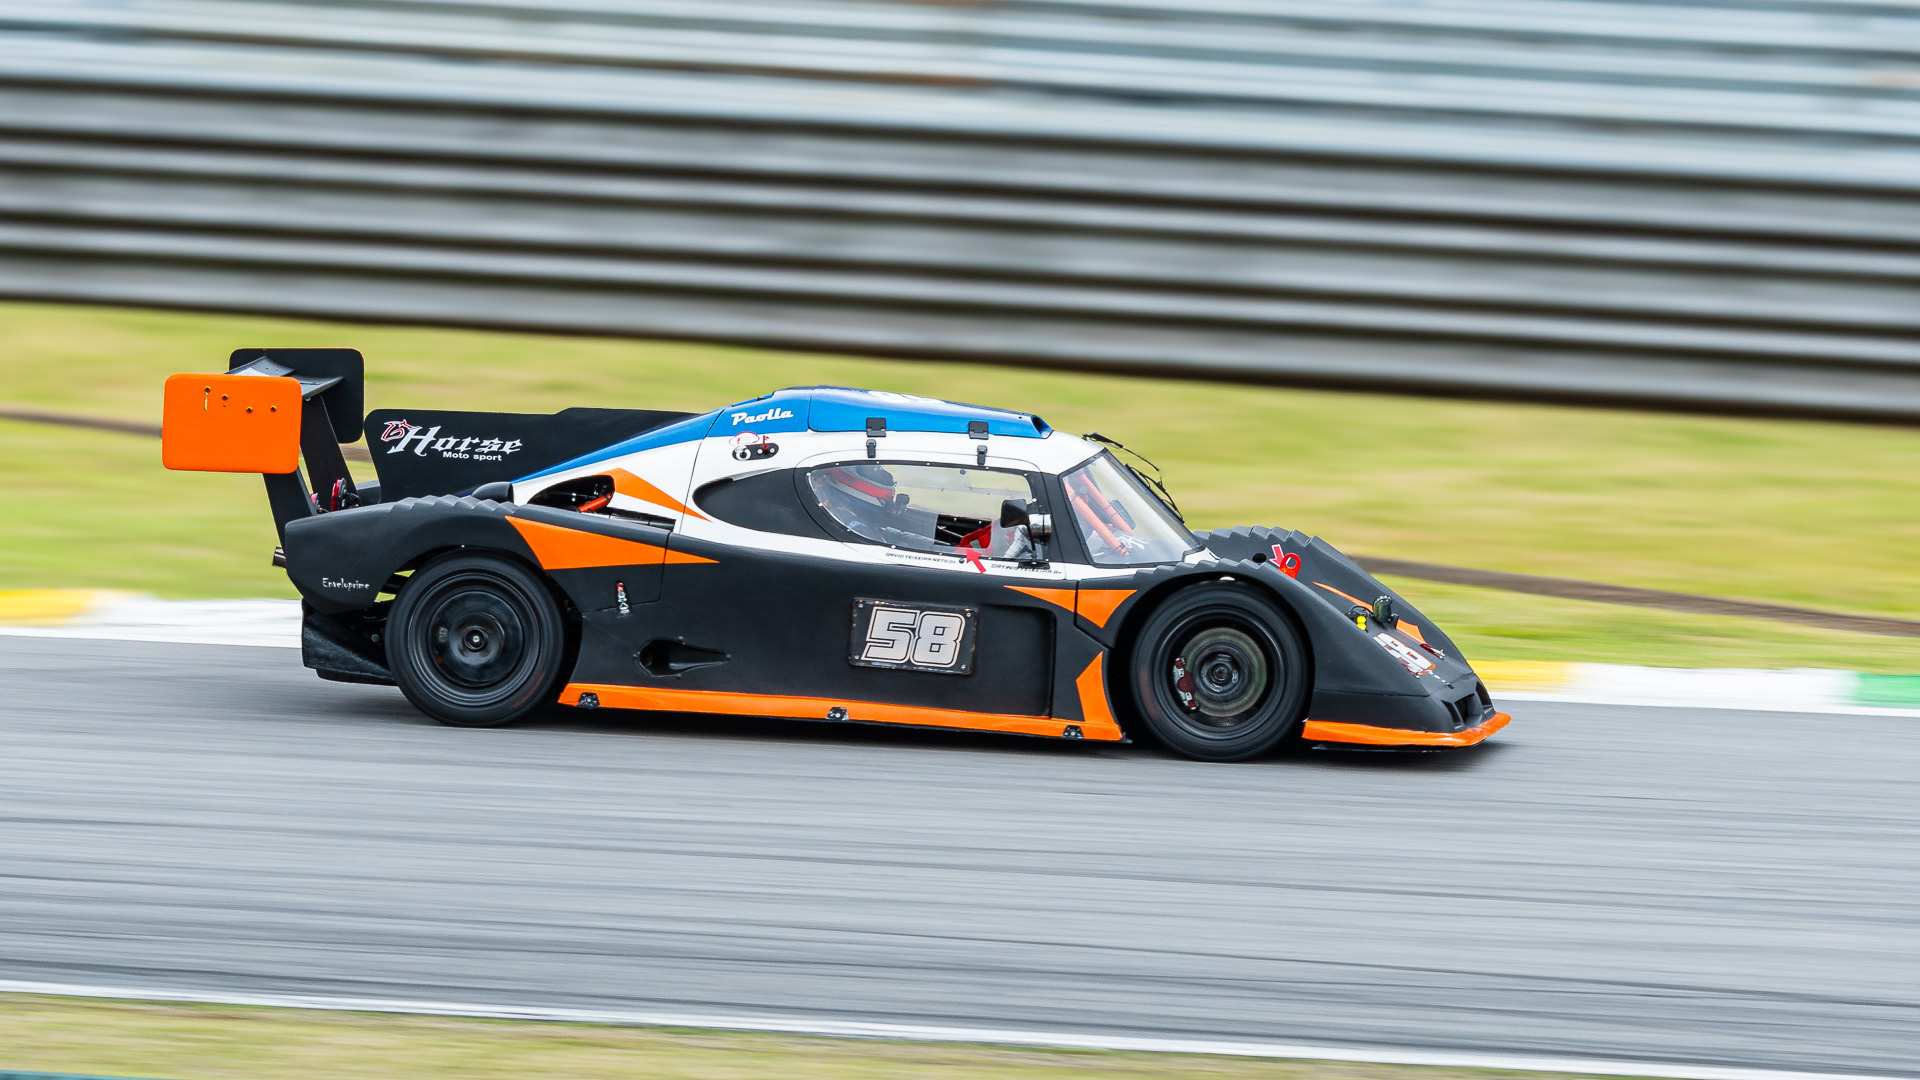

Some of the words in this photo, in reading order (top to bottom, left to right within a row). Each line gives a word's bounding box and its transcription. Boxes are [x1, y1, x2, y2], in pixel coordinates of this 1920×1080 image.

[731, 408, 794, 426] Paolla
[443, 451, 470, 460] Moto
[473, 453, 503, 462] sport
[861, 606, 966, 668] 58
